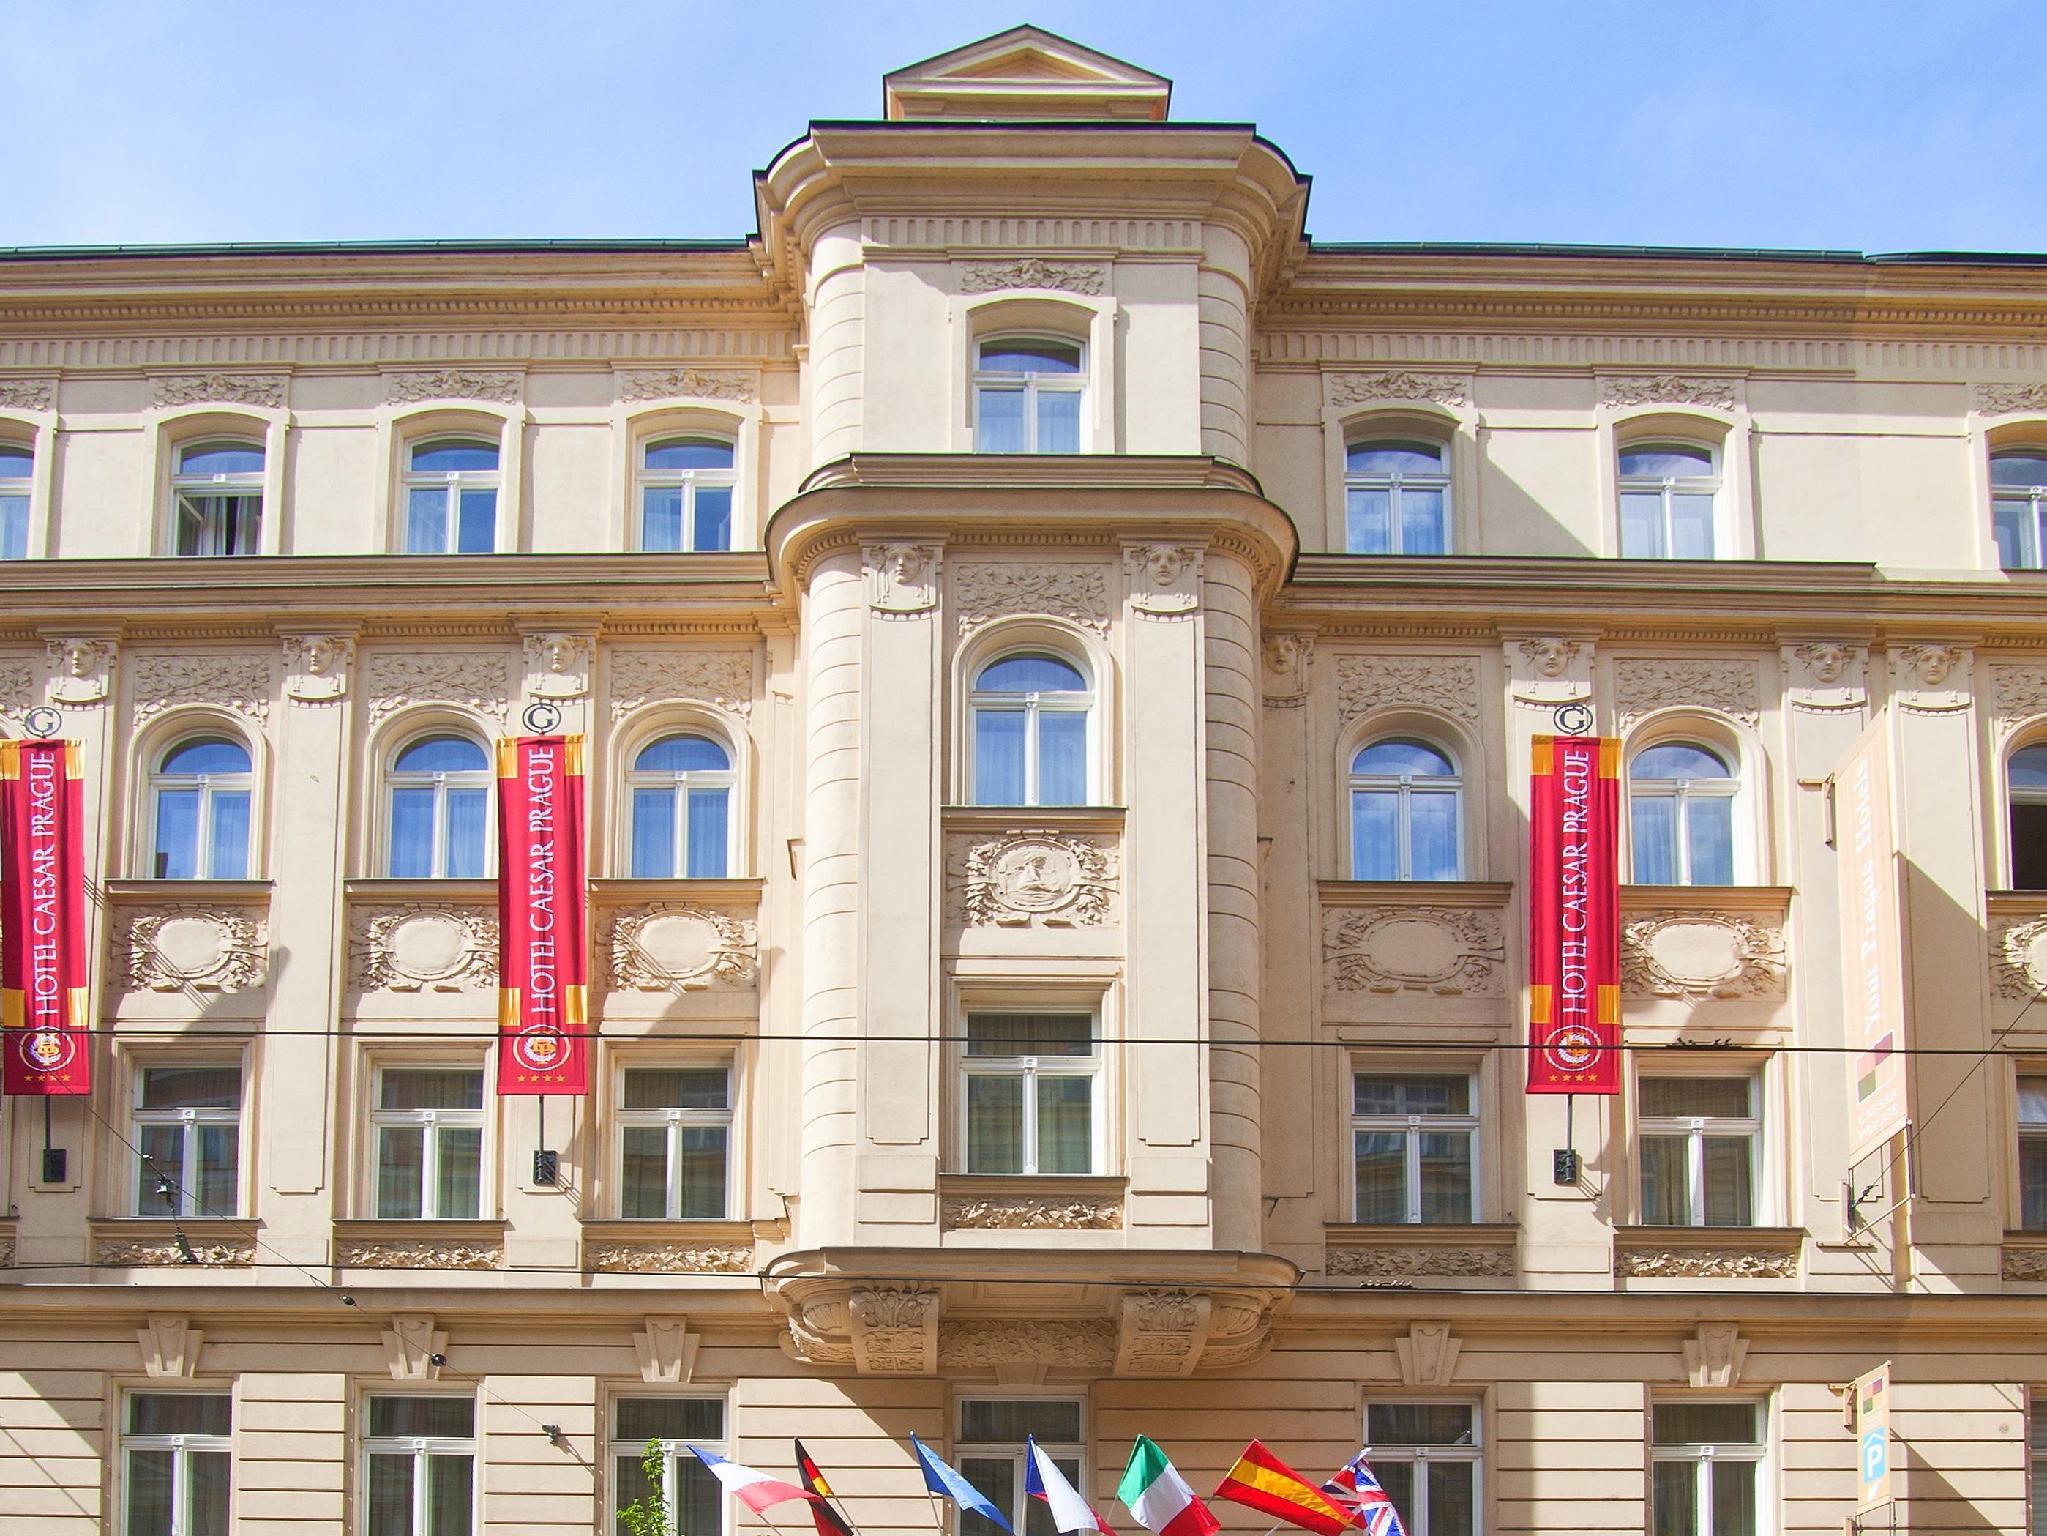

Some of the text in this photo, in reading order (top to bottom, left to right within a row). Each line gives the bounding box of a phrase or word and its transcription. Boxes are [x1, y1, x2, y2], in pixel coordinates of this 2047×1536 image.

[29, 751, 59, 1016] HOTEL CAESAR PRAGUE
[528, 747, 556, 1014] HOTEL CAESAR PRAGUE
[1562, 749, 1590, 1014] HOTEL CAESAR PRAGUE
[1866, 1443, 1883, 1478] P
